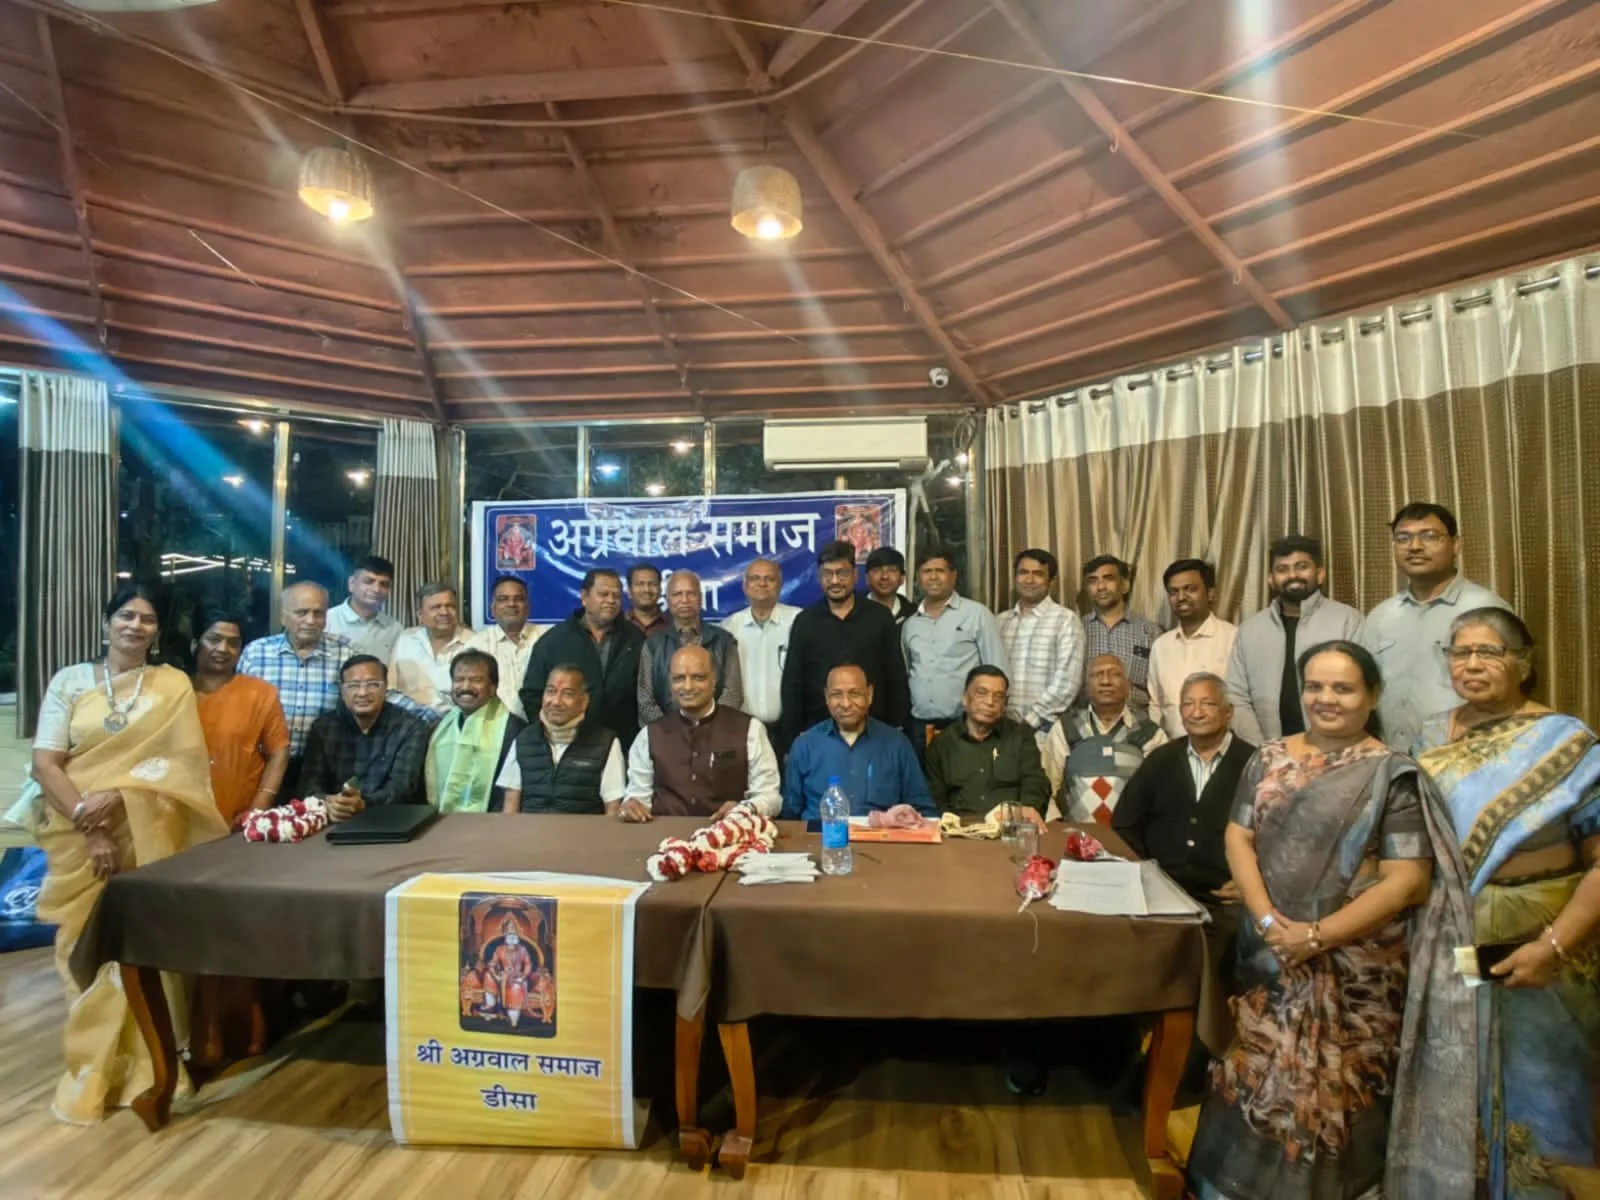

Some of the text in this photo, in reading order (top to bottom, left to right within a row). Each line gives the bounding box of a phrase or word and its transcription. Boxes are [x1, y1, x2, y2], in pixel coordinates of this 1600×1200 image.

[700, 512, 821, 558] समाज
[416, 1038, 602, 1077] श्री अग्रवाल समाज
[479, 1084, 538, 1110] डीसा
